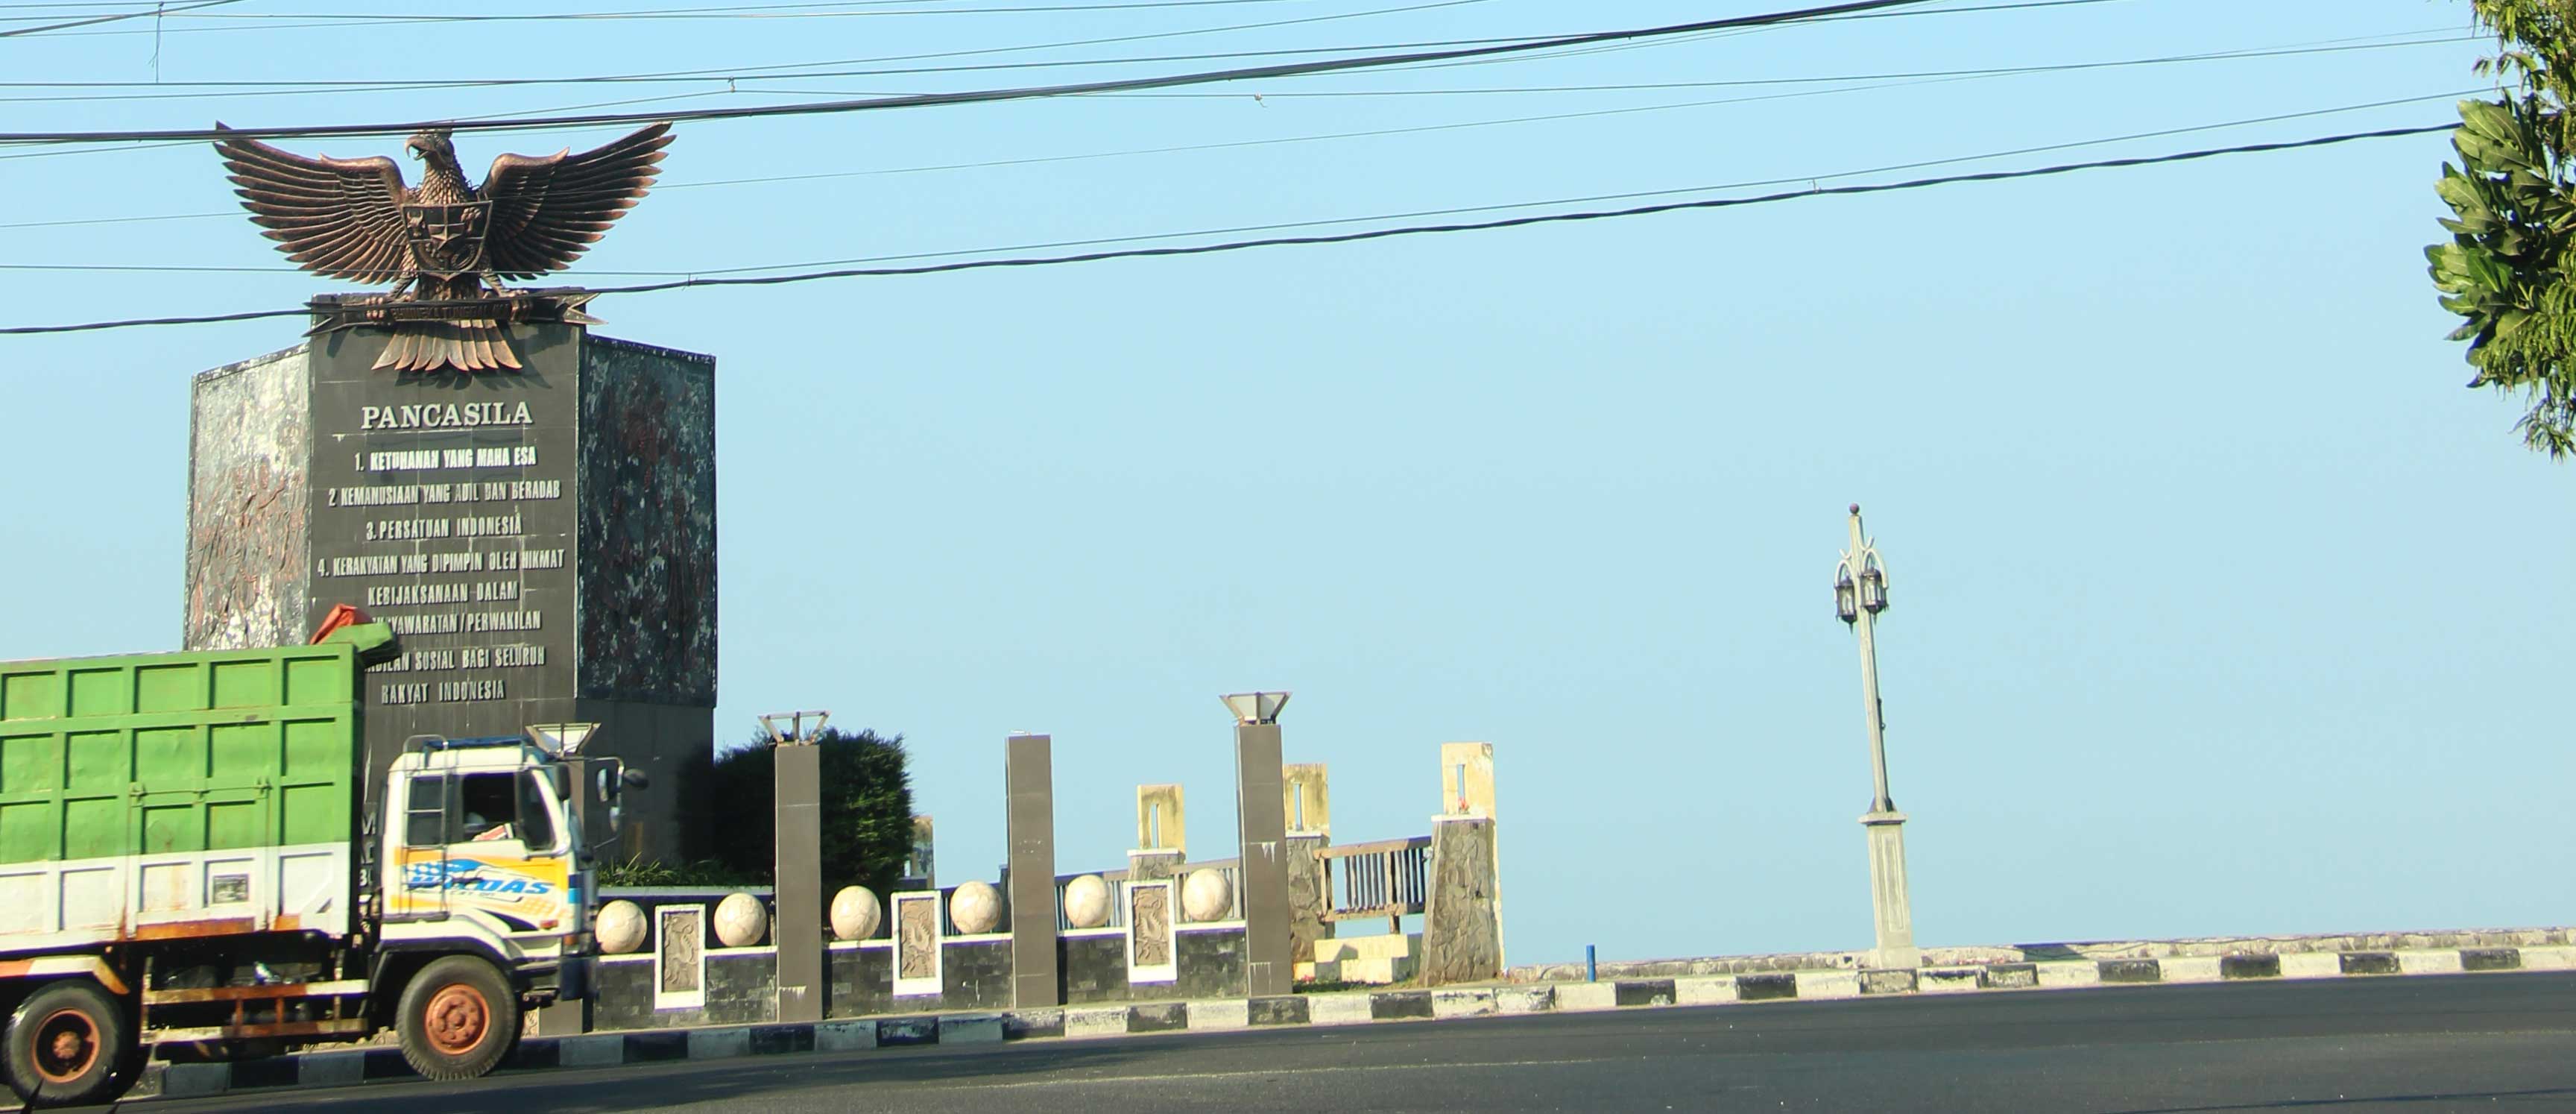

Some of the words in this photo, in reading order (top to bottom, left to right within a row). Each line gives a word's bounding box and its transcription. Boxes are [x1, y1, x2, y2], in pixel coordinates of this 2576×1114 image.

[361, 401, 533, 430] PANCASILA
[355, 453, 364, 471] 1.
[370, 450, 440, 471] KETUHANAN
[443, 449, 473, 468] YANG
[476, 448, 511, 467] MAHA
[514, 447, 537, 466] ESA
[341, 485, 419, 507] KEMANUSIAAN
[423, 483, 450, 503] YANG
[455, 483, 479, 502] ADIL
[484, 482, 508, 501] DAN
[511, 480, 561, 500] BERADAB
[366, 521, 377, 541] 3.
[379, 518, 449, 540] PERSATUAN
[457, 512, 522, 536] INDONESIA
[318, 558, 330, 576] 4.
[333, 555, 398, 576] KERAKYATAN
[401, 554, 428, 574] YANG
[432, 552, 483, 573] DIPIMPIN
[489, 550, 517, 570] OLEH
[522, 549, 565, 570] HIKMAT
[368, 584, 469, 606] KEBIJAKSANAAN
[476, 581, 518, 601] DALAM
[415, 649, 455, 670] SOSIAL
[461, 648, 490, 669] BAGI
[495, 646, 546, 667] SELURUH
[382, 683, 429, 705] RAKYAT
[438, 679, 505, 702] INDONESIA
